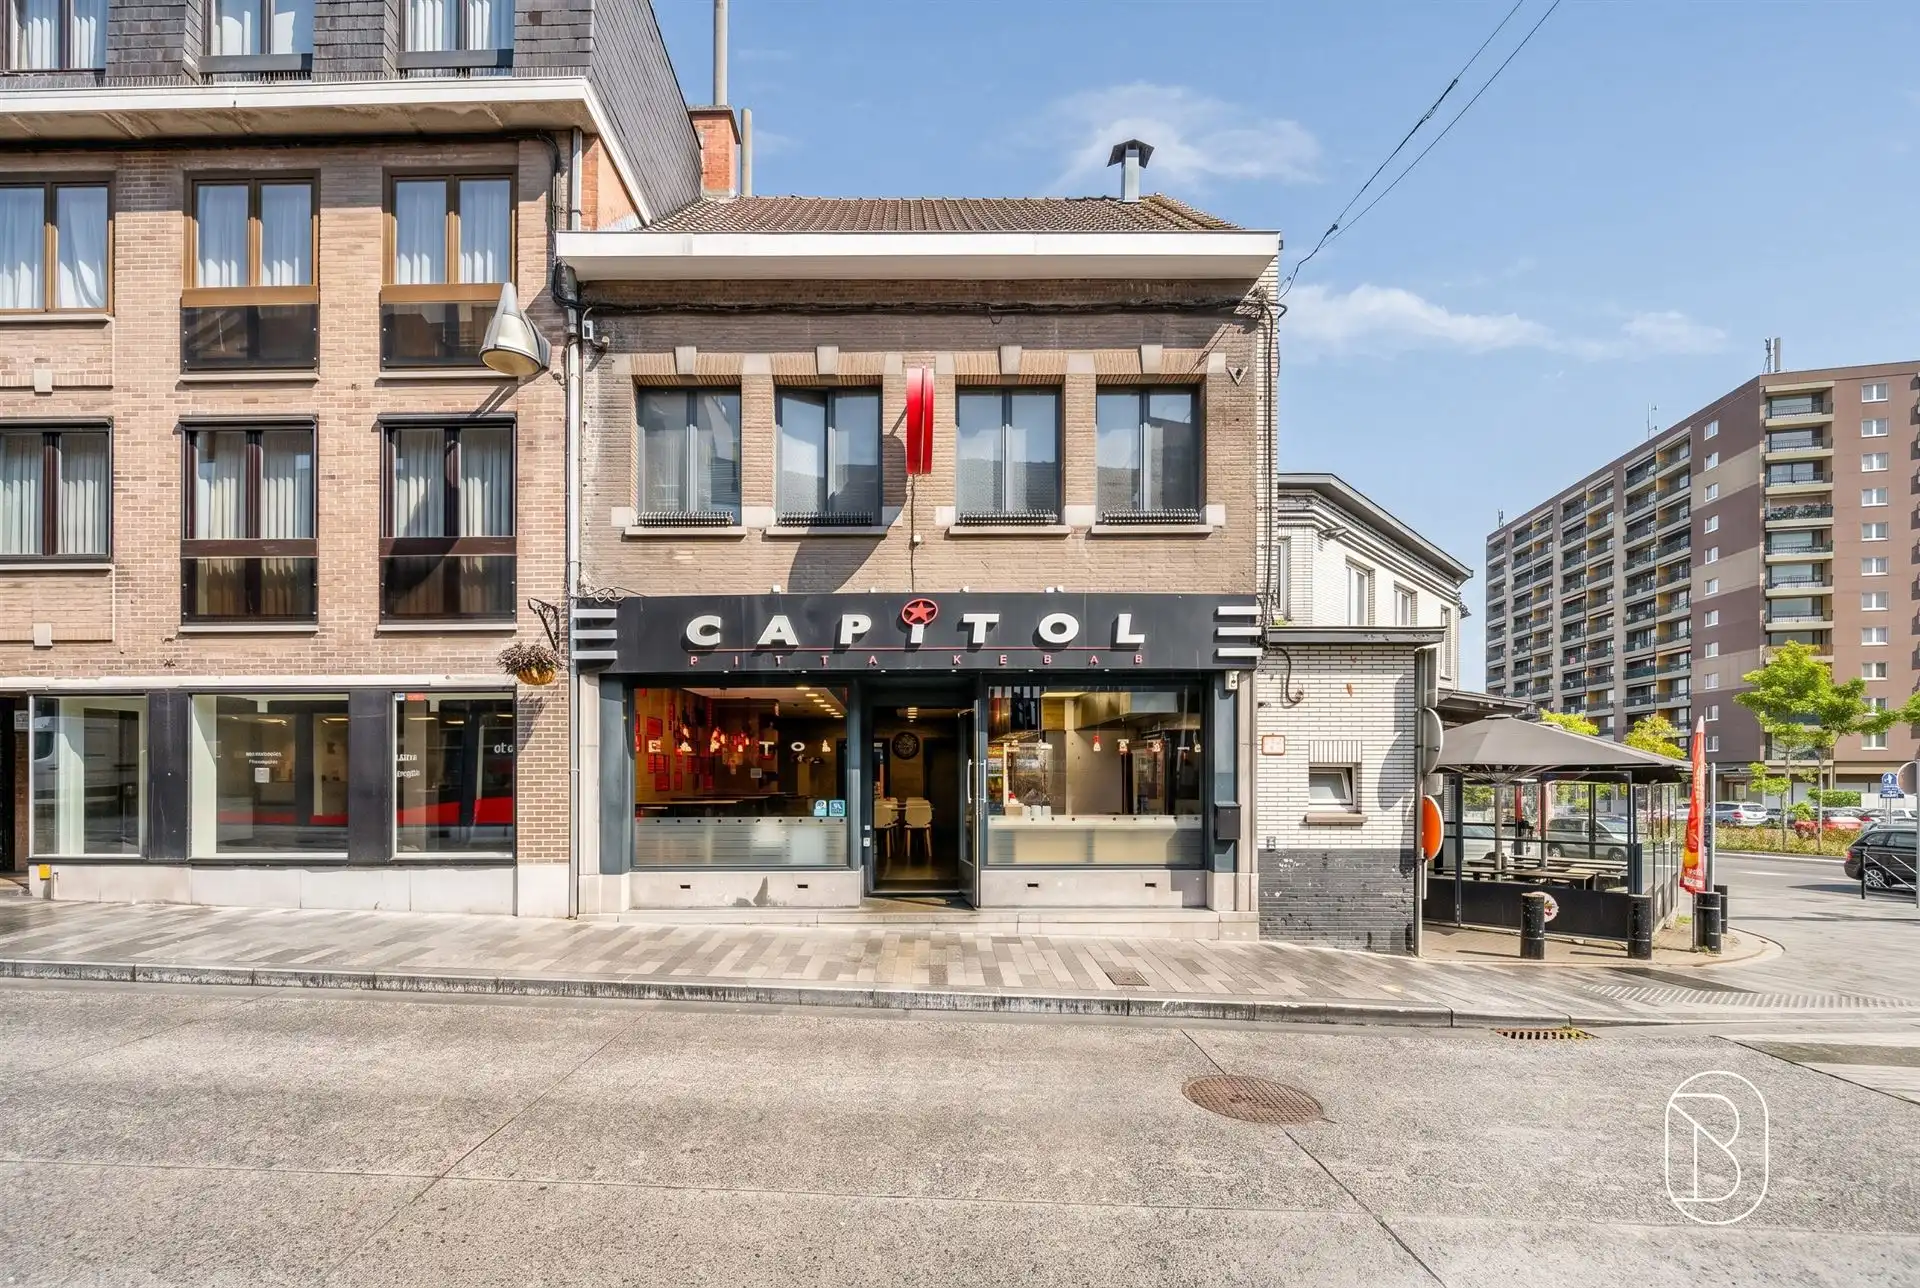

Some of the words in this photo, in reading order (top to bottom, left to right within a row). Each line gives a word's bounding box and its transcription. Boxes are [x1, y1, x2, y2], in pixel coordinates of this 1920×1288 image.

[686, 601, 1146, 646] CAPITOL
[690, 655, 878, 666] PITTA
[953, 654, 1143, 666] KEBAB
